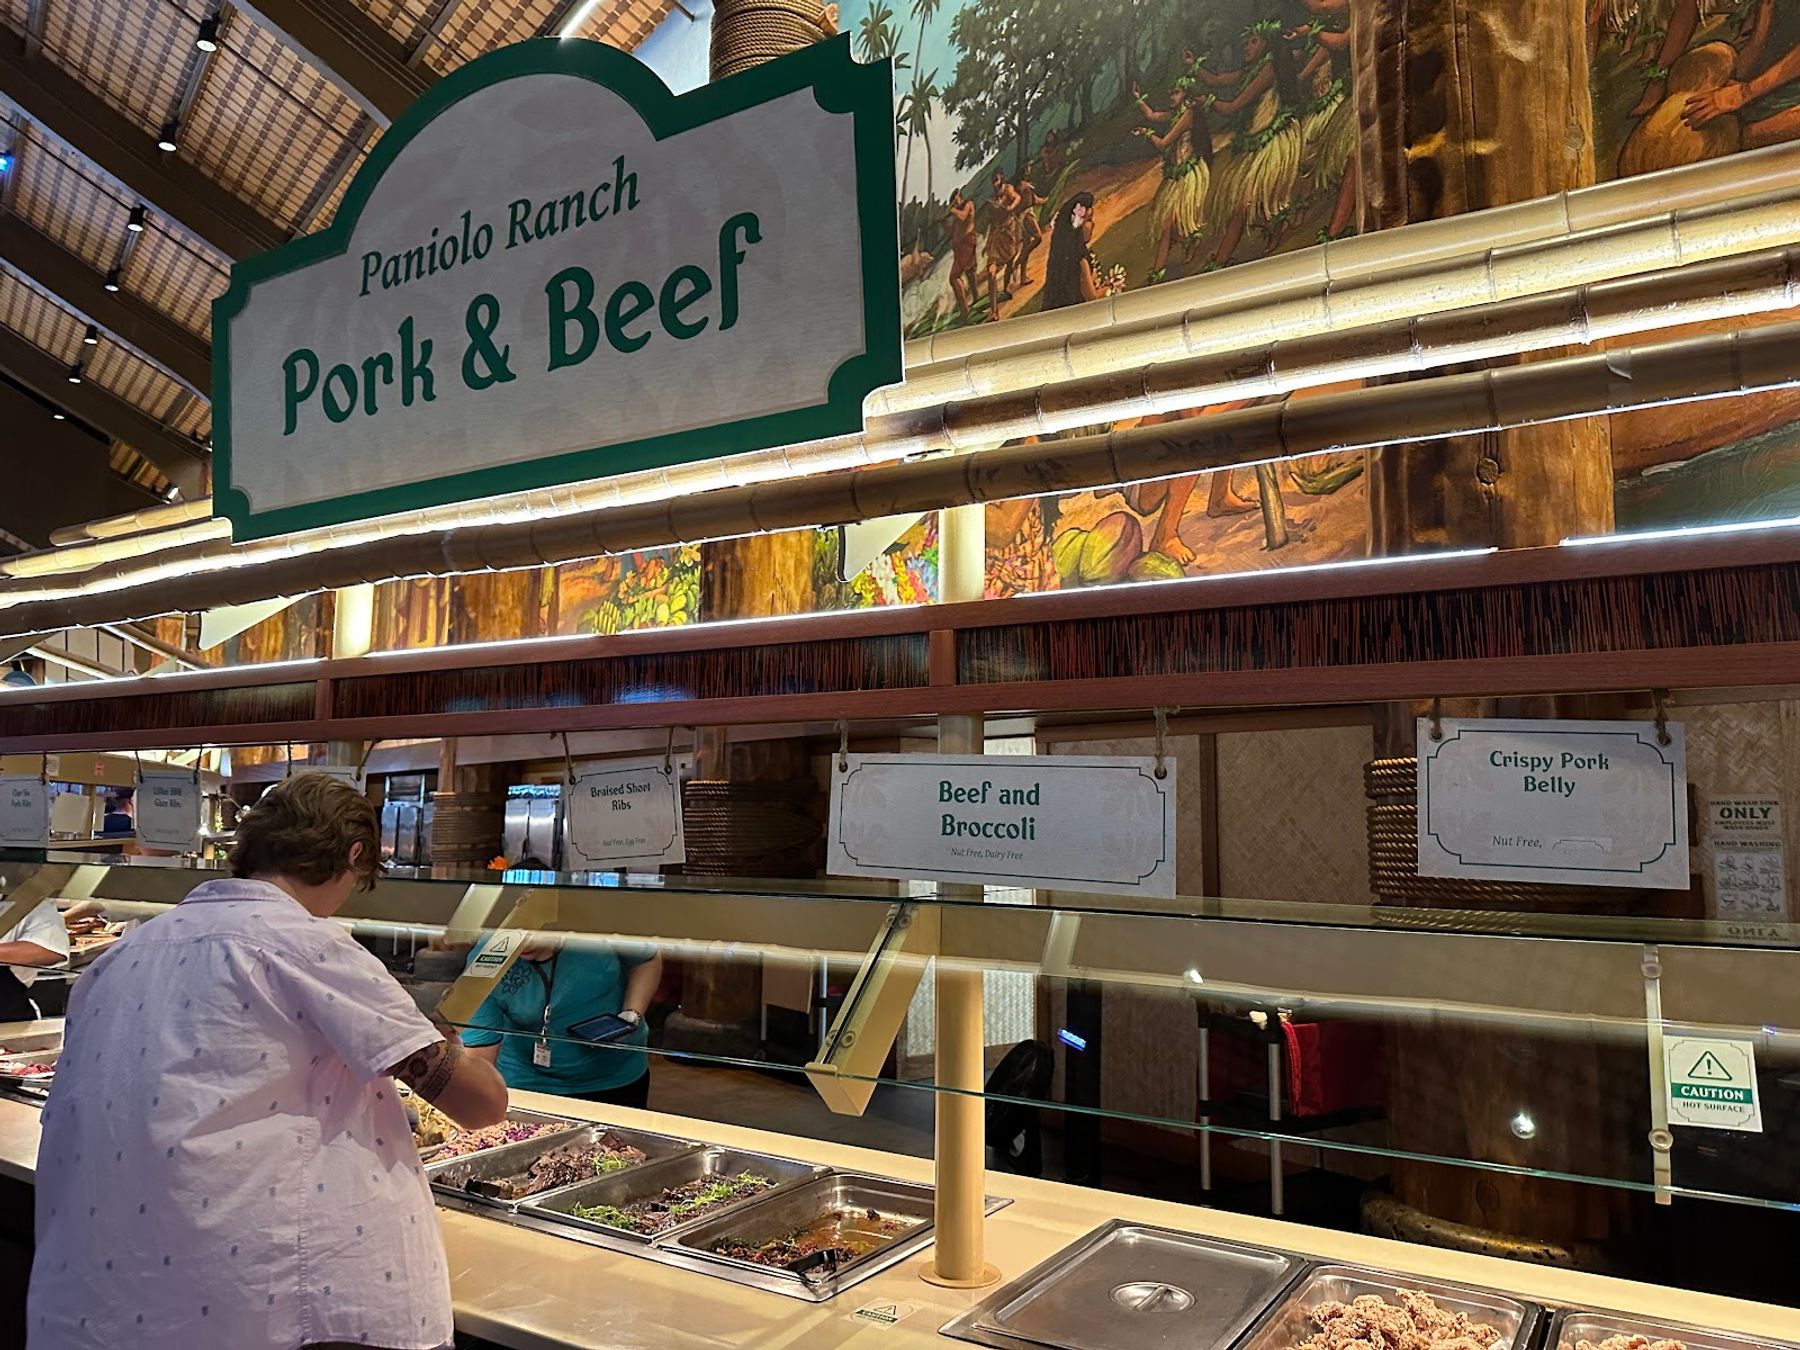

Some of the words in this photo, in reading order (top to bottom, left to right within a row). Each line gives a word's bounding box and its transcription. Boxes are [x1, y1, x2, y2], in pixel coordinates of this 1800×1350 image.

[359, 208, 493, 297] Paniolo
[504, 155, 639, 250] Ranch
[282, 315, 437, 436] Pork
[462, 293, 516, 390] &
[544, 211, 763, 372] Beef
[1489, 750, 1553, 772] Crispy
[1560, 752, 1609, 770] Pork
[590, 784, 625, 797] Braised
[626, 782, 651, 794] Short
[938, 780, 992, 804] Beef
[999, 783, 1040, 806] and
[1523, 775, 1575, 797] Belly
[611, 800, 632, 811] Ribs
[1720, 807, 1771, 819] ONLY
[941, 814, 1036, 841] Broccoli
[1492, 836, 1513, 847] Nut
[1516, 836, 1543, 849] Free,
[951, 848, 965, 856] Nut
[966, 849, 984, 858] Free,
[985, 849, 1006, 860] Dairy
[1006, 850, 1023, 860] Free
[1681, 1086, 1744, 1101] CAUTION
[1682, 1101, 1701, 1109] HOT
[1704, 1103, 1744, 1112] SURFACE
